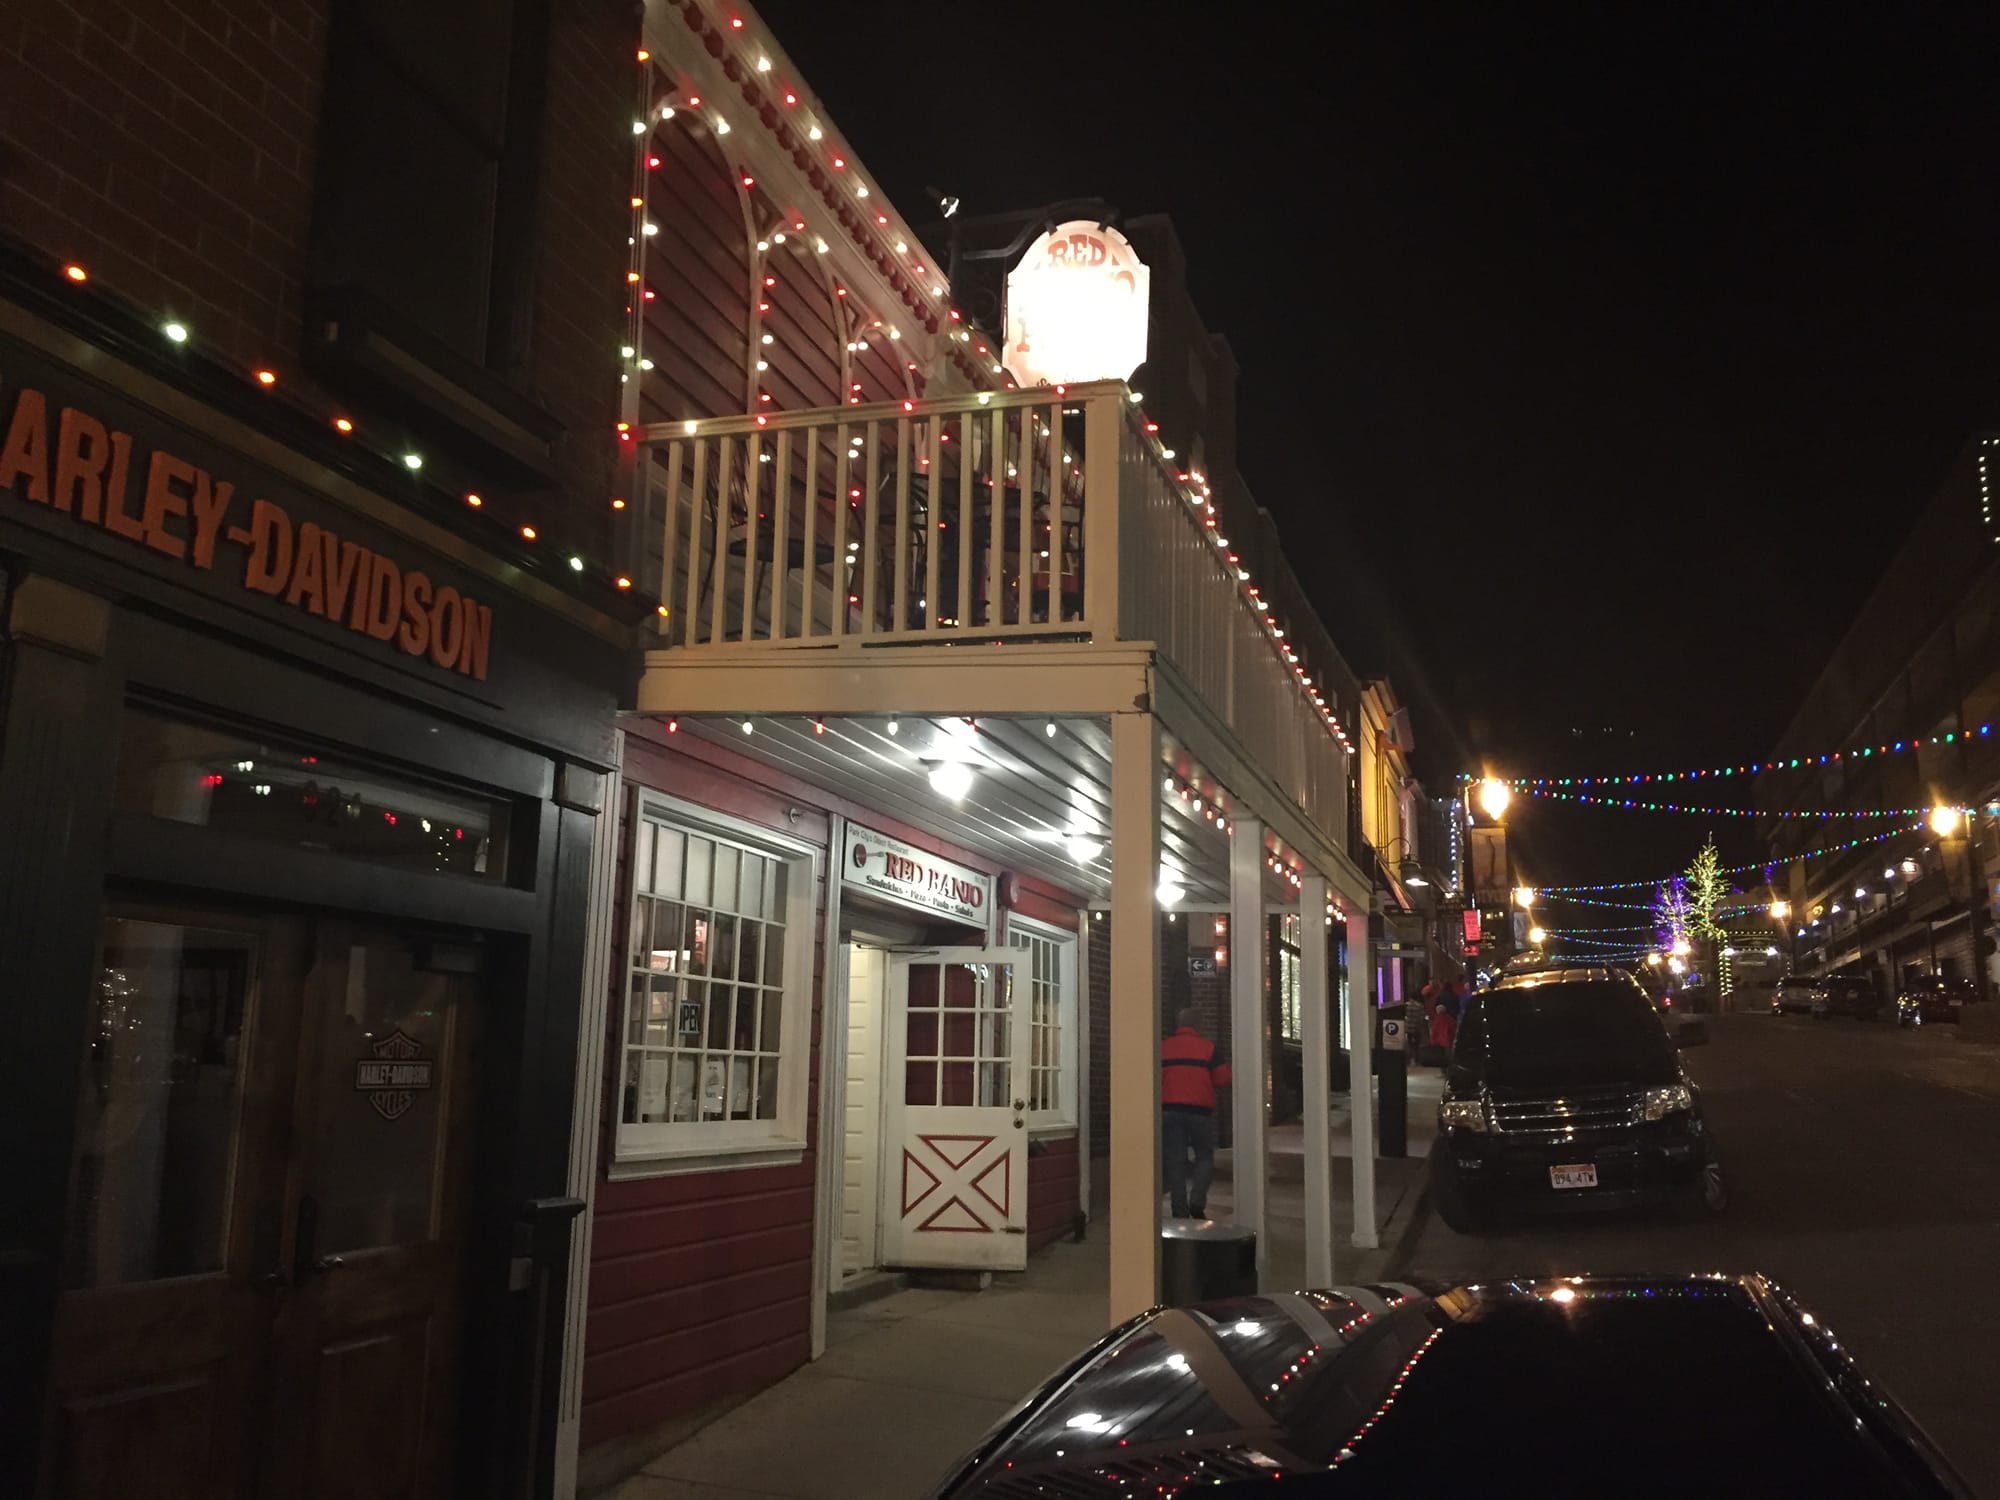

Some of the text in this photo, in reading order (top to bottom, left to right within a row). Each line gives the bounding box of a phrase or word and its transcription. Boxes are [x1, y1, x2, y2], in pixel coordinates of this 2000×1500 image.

[1048, 234, 1107, 268] RED
[885, 851, 983, 908] RED BANJO
